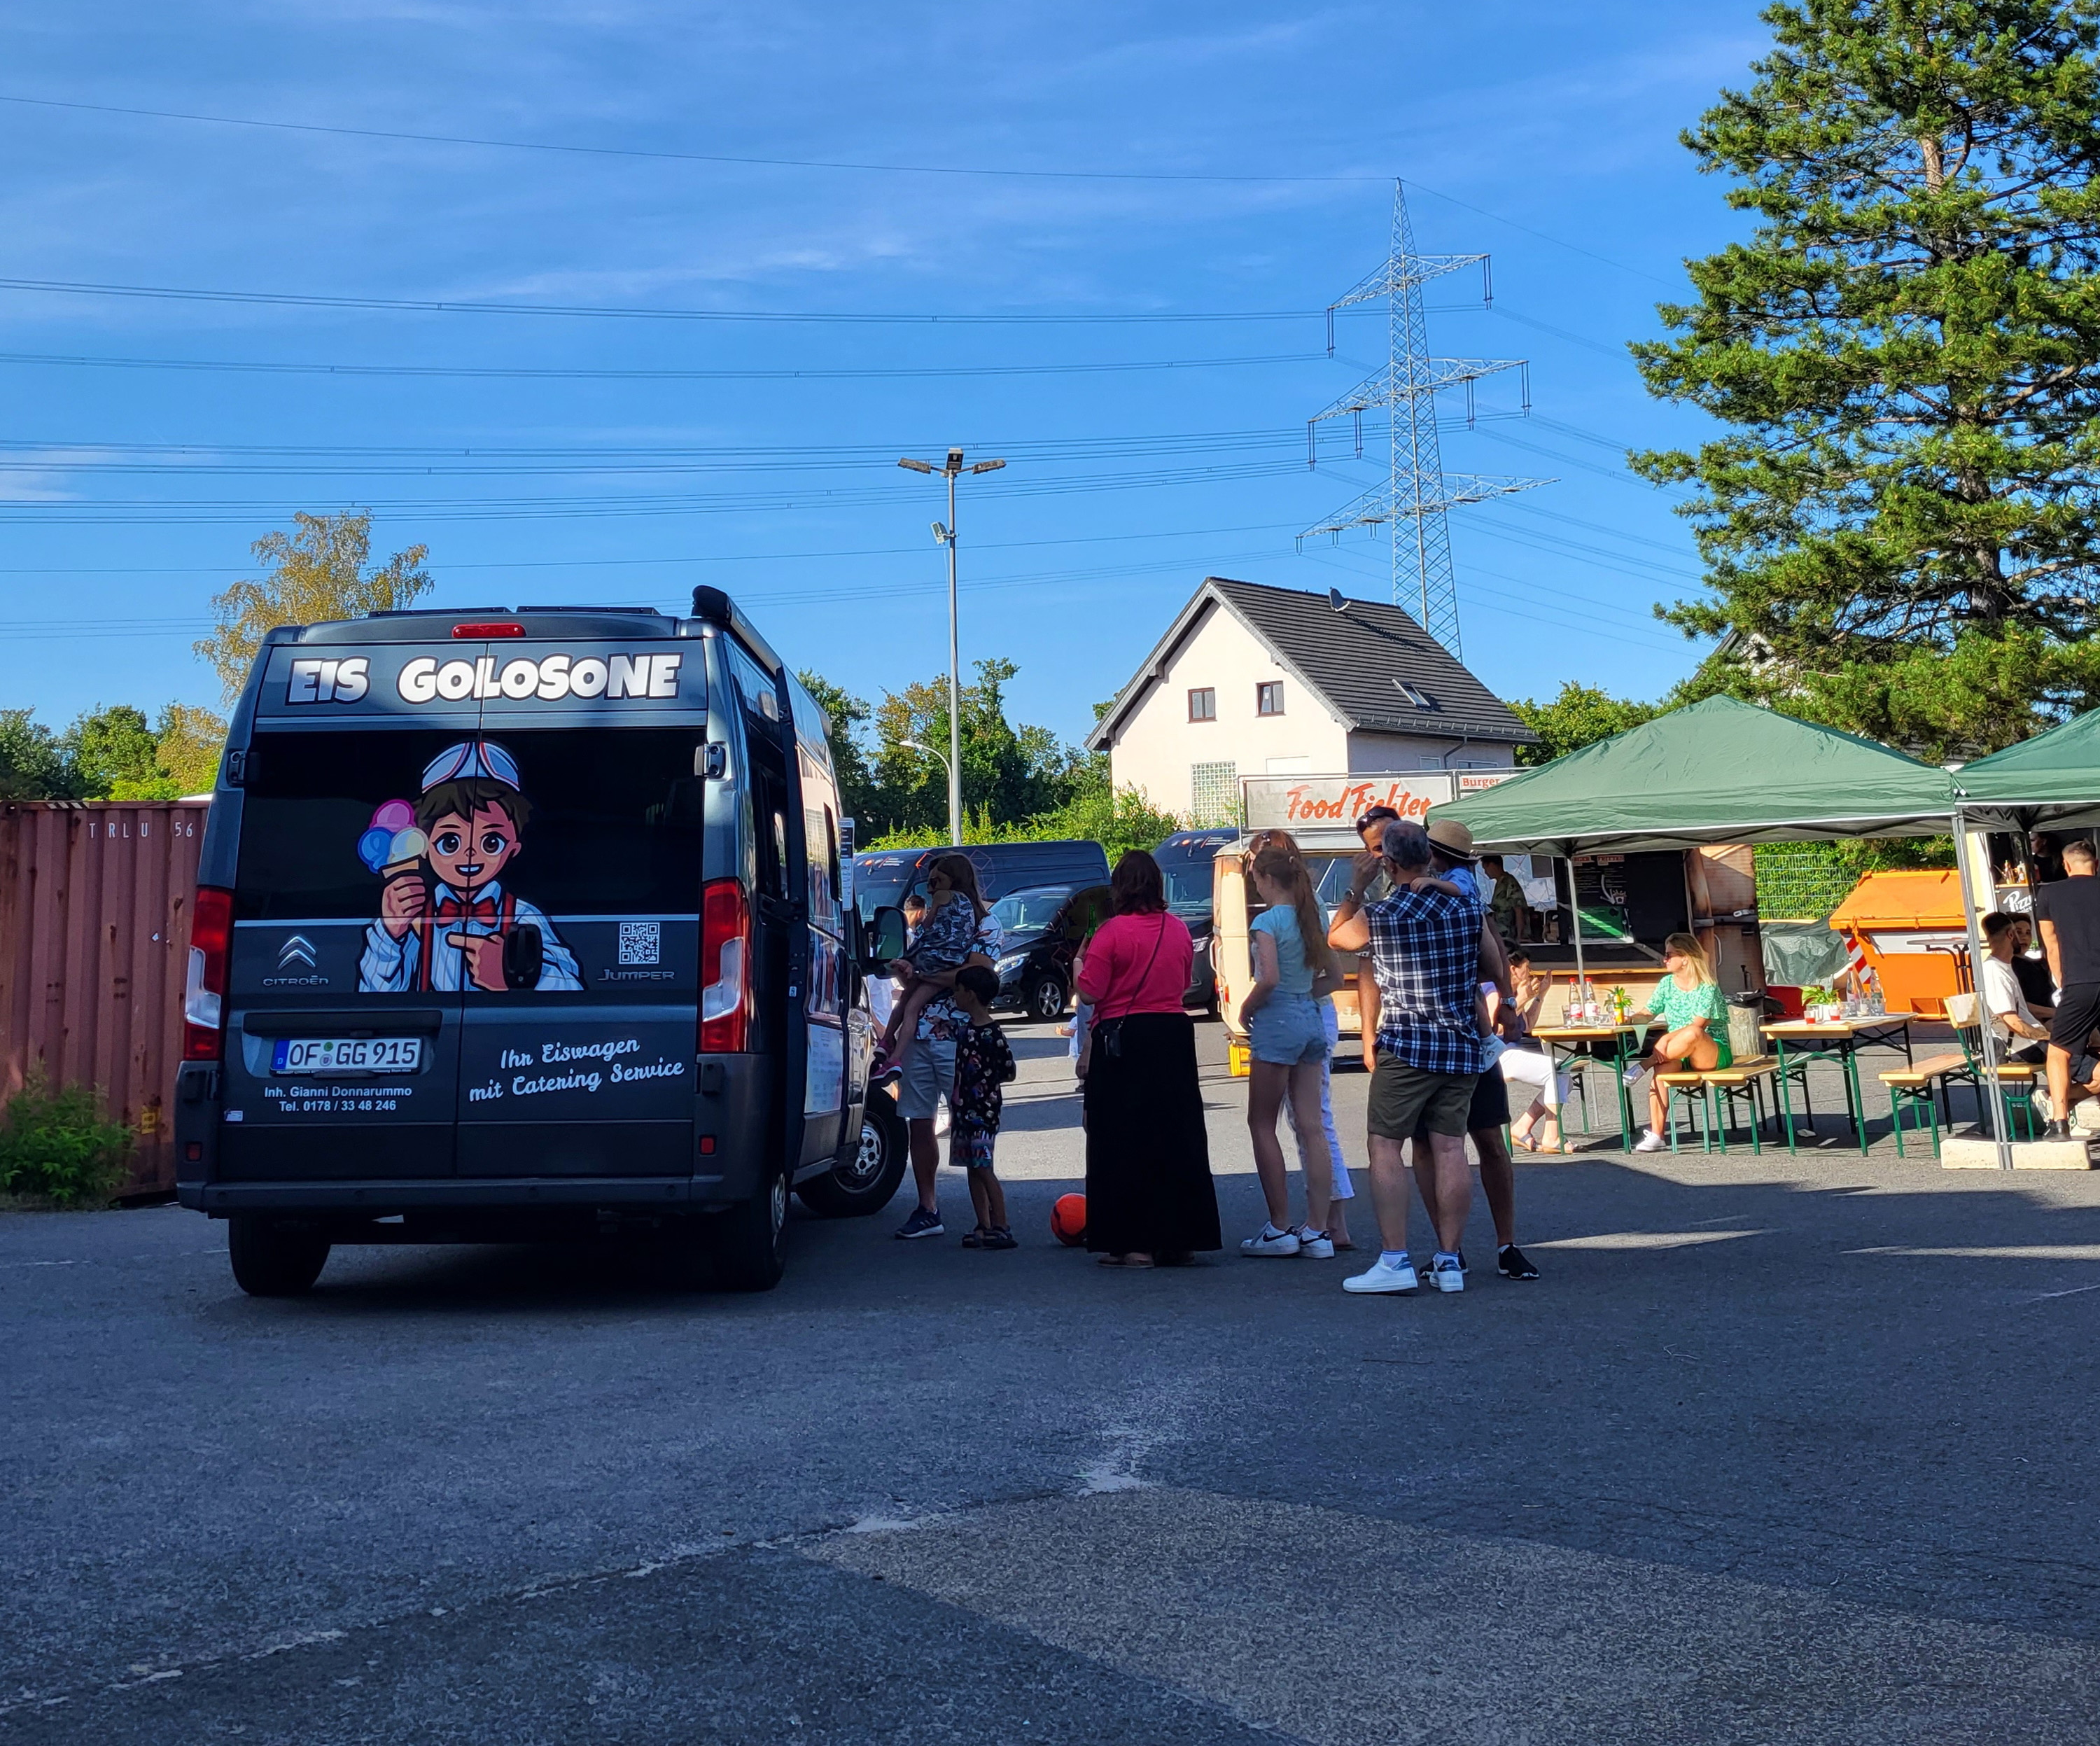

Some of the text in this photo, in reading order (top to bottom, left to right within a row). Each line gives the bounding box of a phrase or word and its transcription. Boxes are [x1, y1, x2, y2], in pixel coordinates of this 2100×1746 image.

[286, 652, 683, 706] EIS GOLOSONE
[1462, 778, 1500, 789] Burger
[1287, 784, 1350, 821] Food
[175, 822, 192, 837] 56
[289, 1043, 321, 1066] OF
[335, 1042, 367, 1065] GG
[372, 1042, 416, 1064] 915
[500, 1039, 640, 1069] Ihr Eiswagen
[469, 1056, 685, 1102] mit Catering Service
[264, 1086, 412, 1098] Inh. Gianni Donnarummo
[279, 1101, 299, 1112] Tel.
[303, 1101, 330, 1111] 0178
[341, 1101, 355, 1111] 33
[358, 1101, 372, 1110] 48
[375, 1100, 396, 1110] 246
